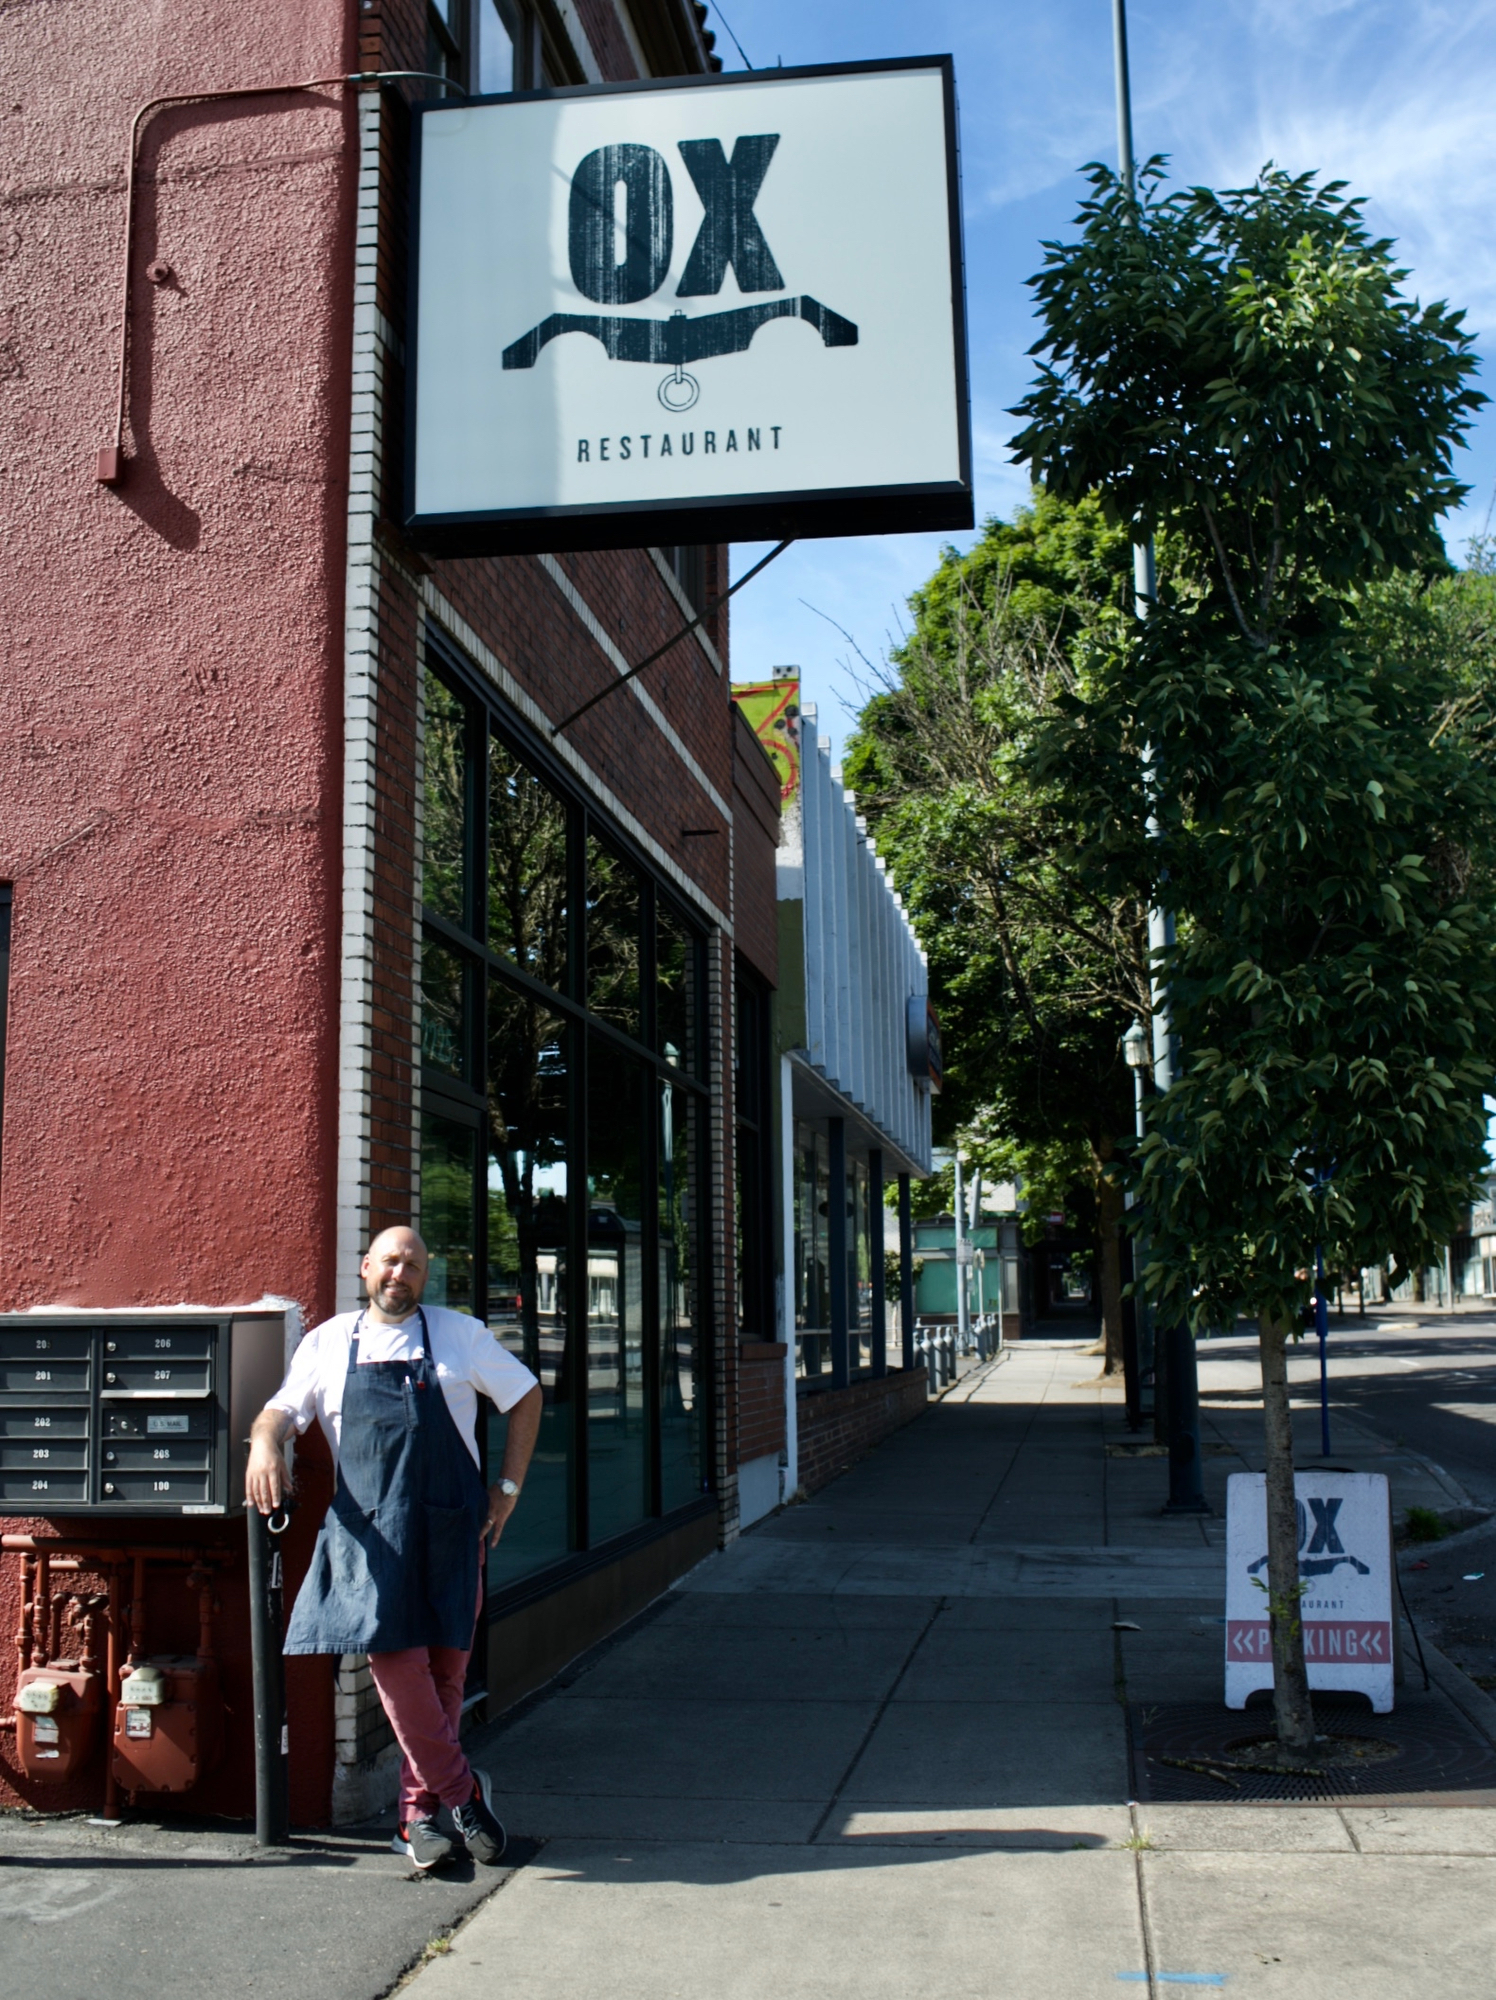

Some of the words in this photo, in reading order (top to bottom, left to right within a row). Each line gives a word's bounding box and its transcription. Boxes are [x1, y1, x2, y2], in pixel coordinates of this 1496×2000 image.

[568, 133, 785, 305] OX
[577, 425, 784, 462] RESTAURANT
[154, 1339, 171, 1349] 206
[35, 1371, 51, 1381] 201
[154, 1371, 171, 1380] 207
[34, 1417, 51, 1427] 202
[33, 1449, 50, 1459] 203
[153, 1449, 170, 1459] 208
[32, 1480, 48, 1490] 204
[153, 1481, 170, 1491] 100
[1301, 1600, 1344, 1609] AURANT
[1258, 1628, 1358, 1656] PKING
